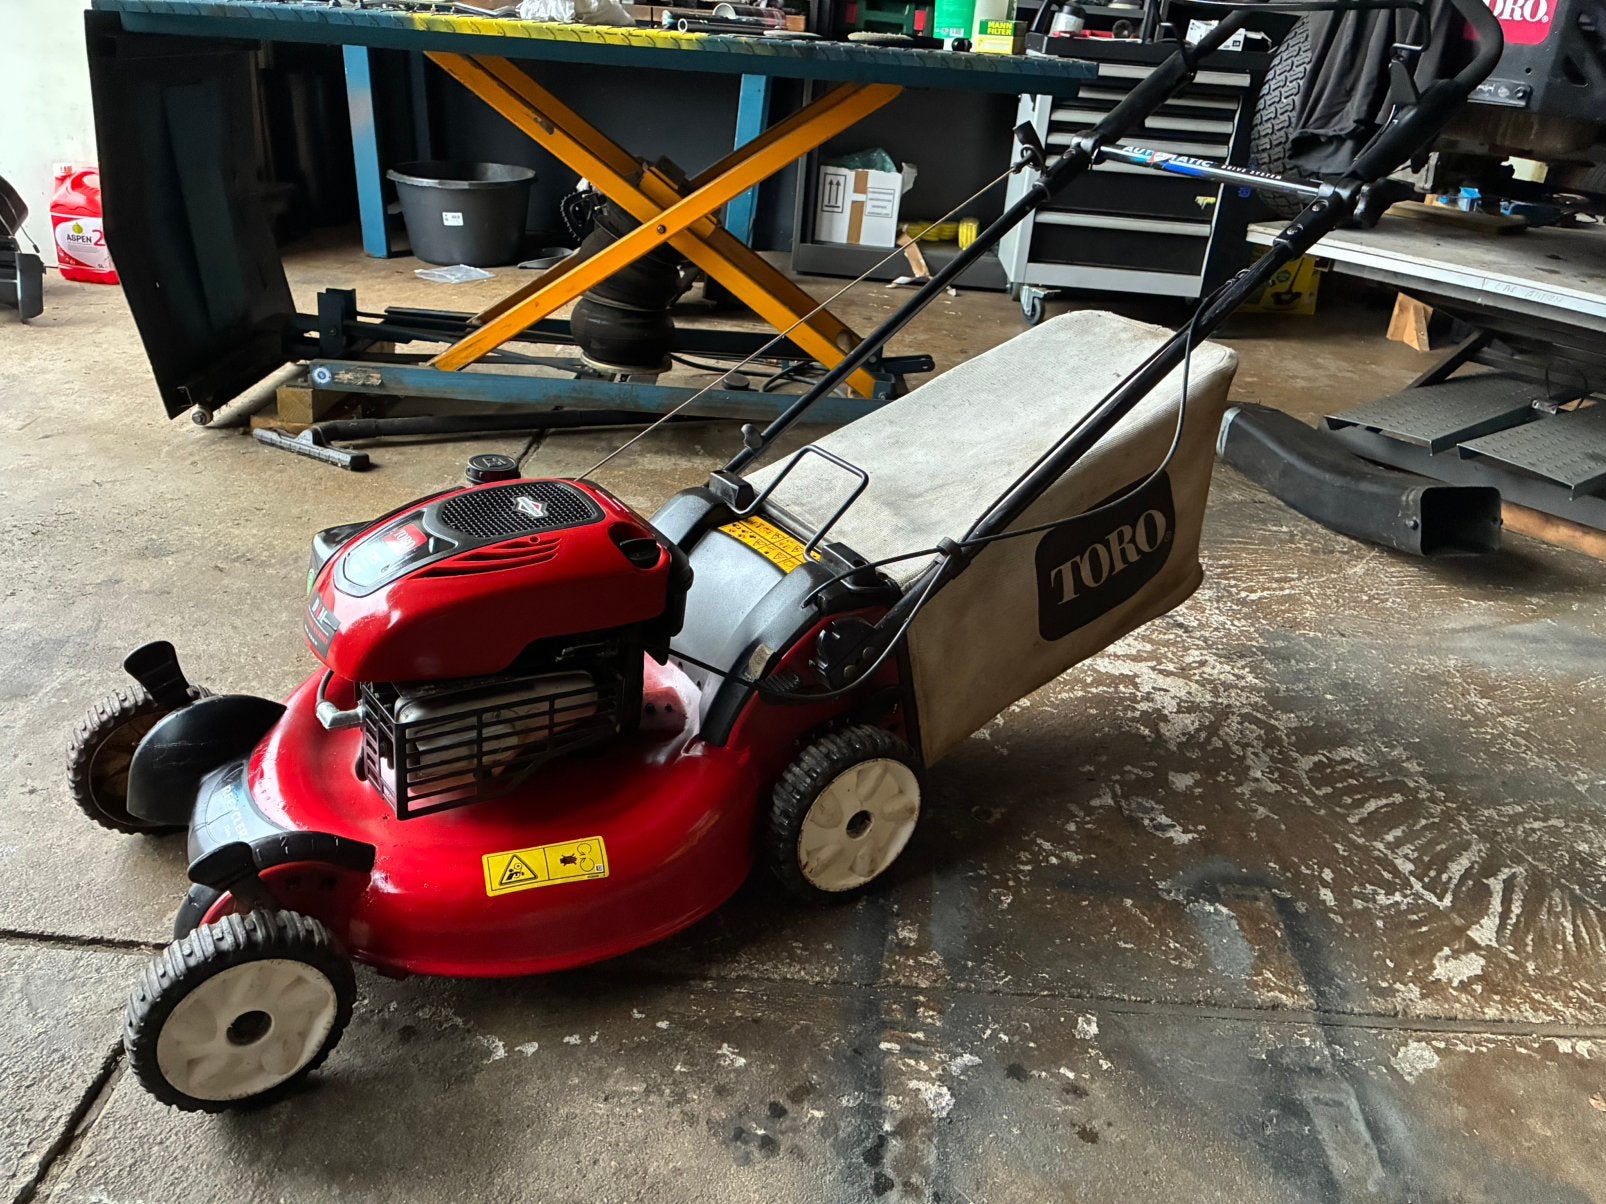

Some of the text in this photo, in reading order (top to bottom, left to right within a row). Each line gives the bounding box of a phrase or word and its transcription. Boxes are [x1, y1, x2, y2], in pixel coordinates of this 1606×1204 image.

[1483, 0, 1548, 22] ORO
[987, 21, 1013, 29] MANN
[1220, 164, 1248, 173] DRIVE
[1249, 171, 1283, 180] SYSTEM
[66, 229, 106, 246] ASPEN 2
[1051, 509, 1167, 605] TORO
